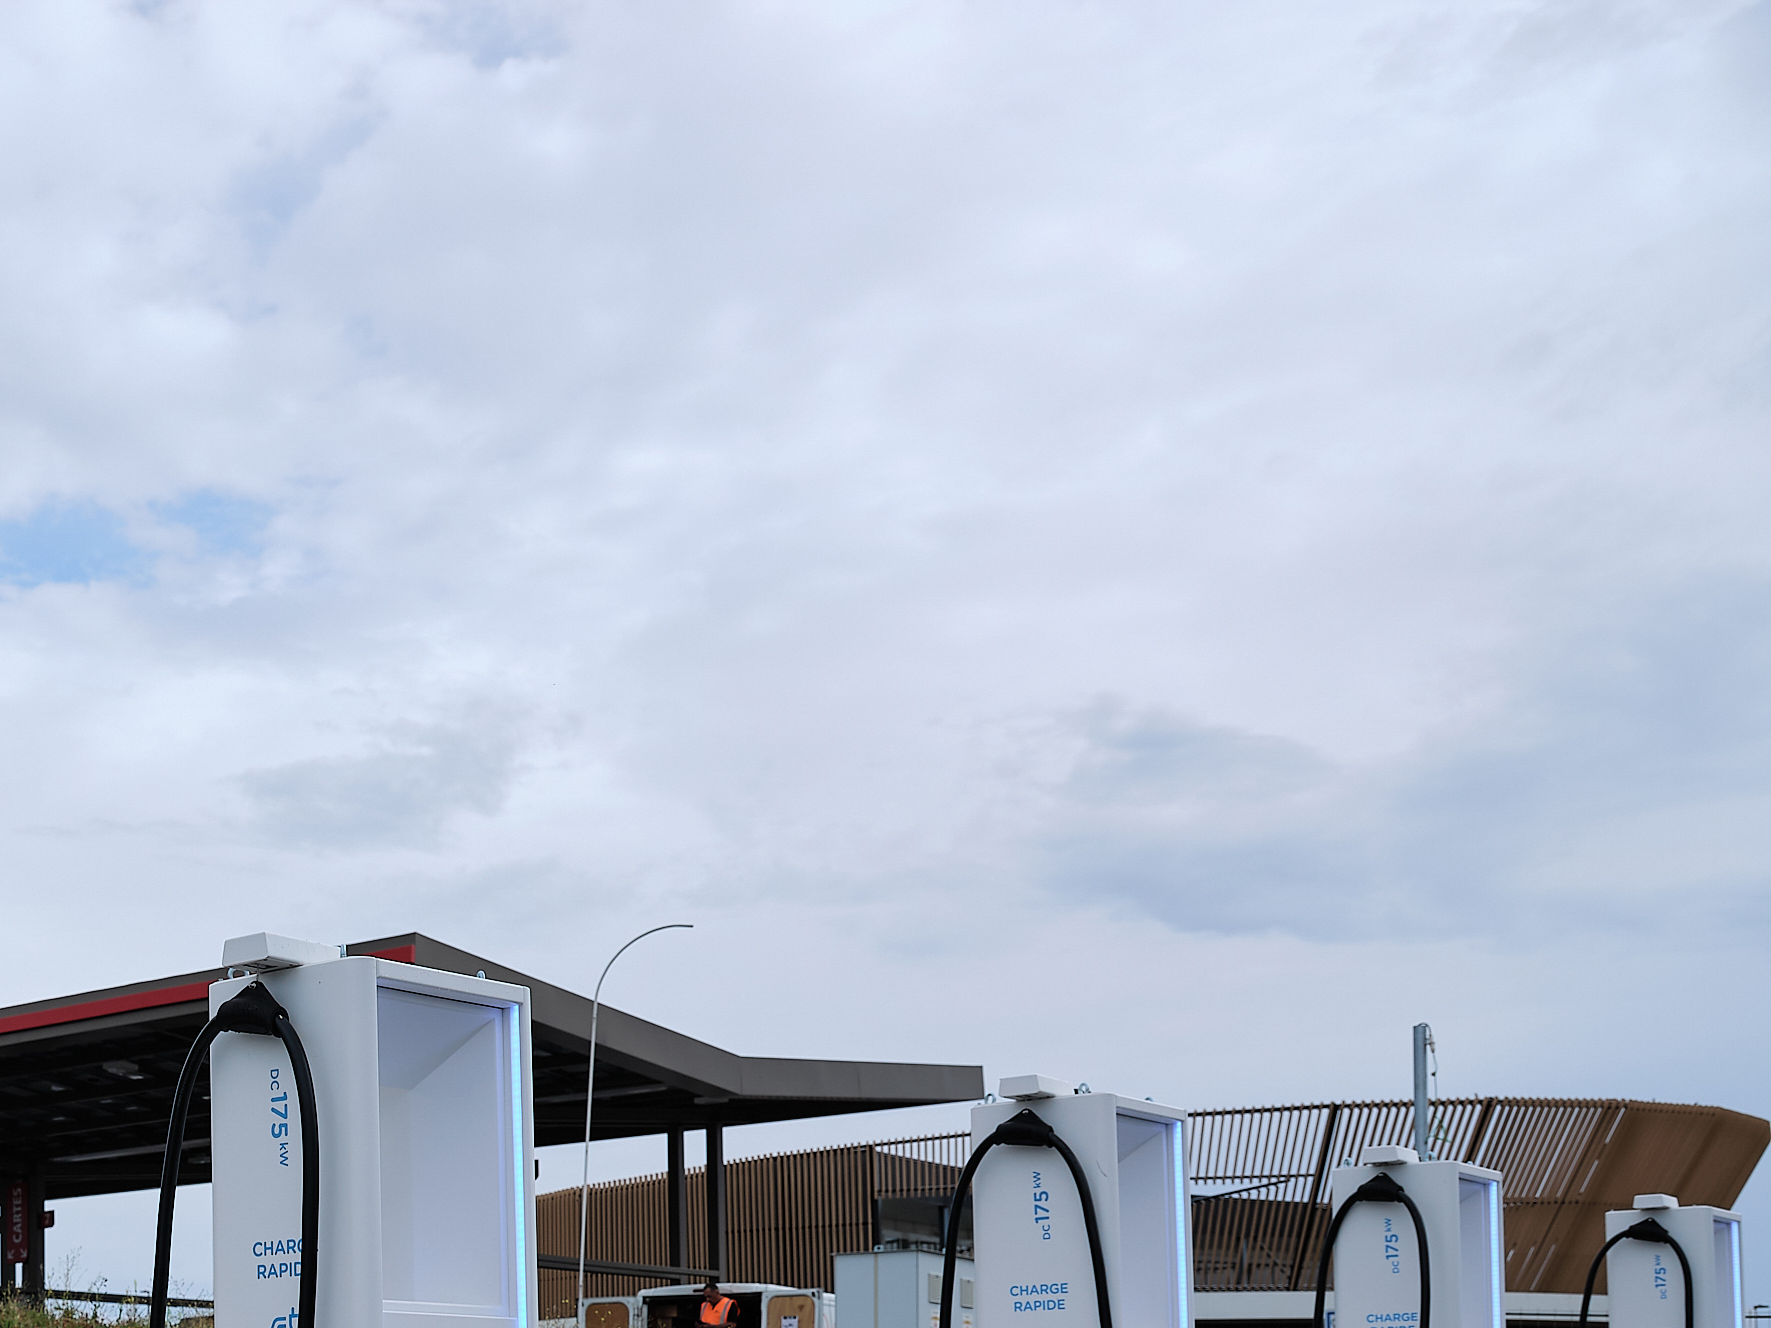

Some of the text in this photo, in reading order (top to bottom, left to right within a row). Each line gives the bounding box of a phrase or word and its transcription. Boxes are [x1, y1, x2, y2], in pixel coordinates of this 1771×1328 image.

[270, 1068, 289, 1167] DC 175 kW
[13, 1188, 22, 1243] CARTES
[1032, 1171, 1051, 1241] DC 175 kW
[253, 1239, 302, 1257] CHAR
[1385, 1233, 1399, 1260] 175
[257, 1262, 301, 1279] RAPID
[1655, 1267, 1667, 1288] 175
[1009, 1282, 1069, 1297] CHARGE
[1013, 1298, 1066, 1313] RAPIDE
[1366, 1312, 1419, 1324] CHARGE
